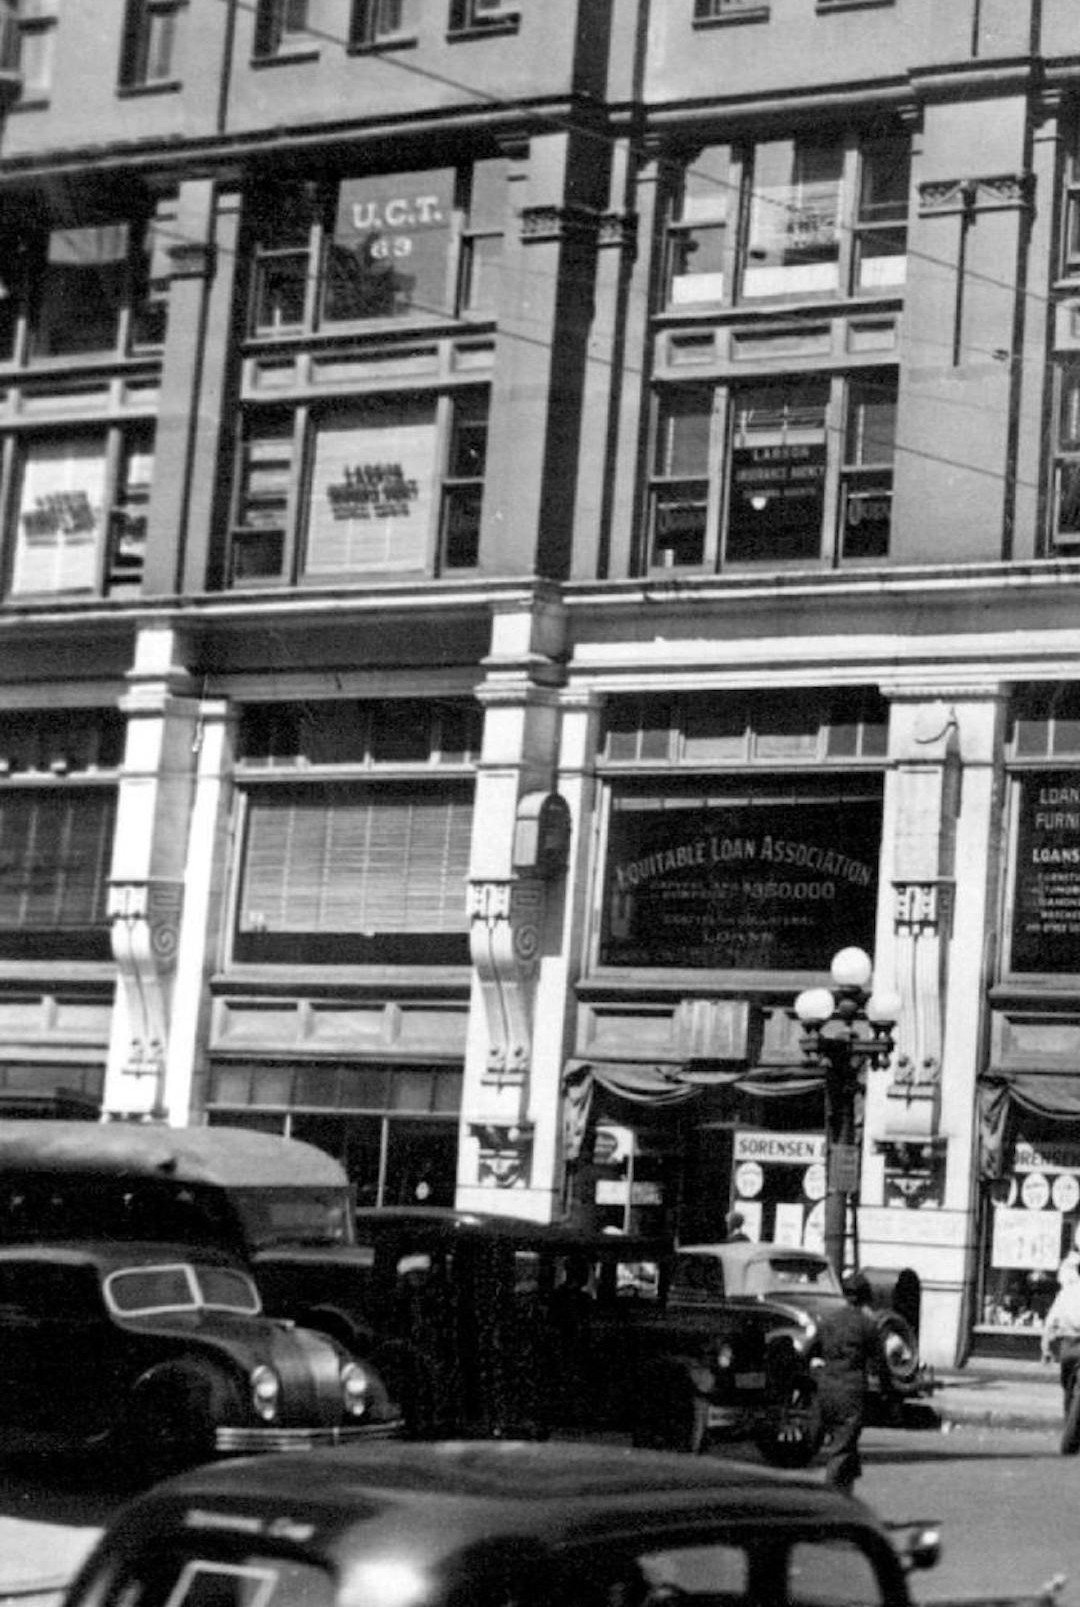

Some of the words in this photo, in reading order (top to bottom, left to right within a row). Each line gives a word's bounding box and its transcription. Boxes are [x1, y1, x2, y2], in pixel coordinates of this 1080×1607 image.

[352, 195, 443, 229] U.C.T.
[710, 837, 757, 861] LOAN
[760, 833, 874, 887] ASSOCIATION
[1032, 848, 1080, 863] LOANS
[738, 1138, 816, 1156] SORENSEN
